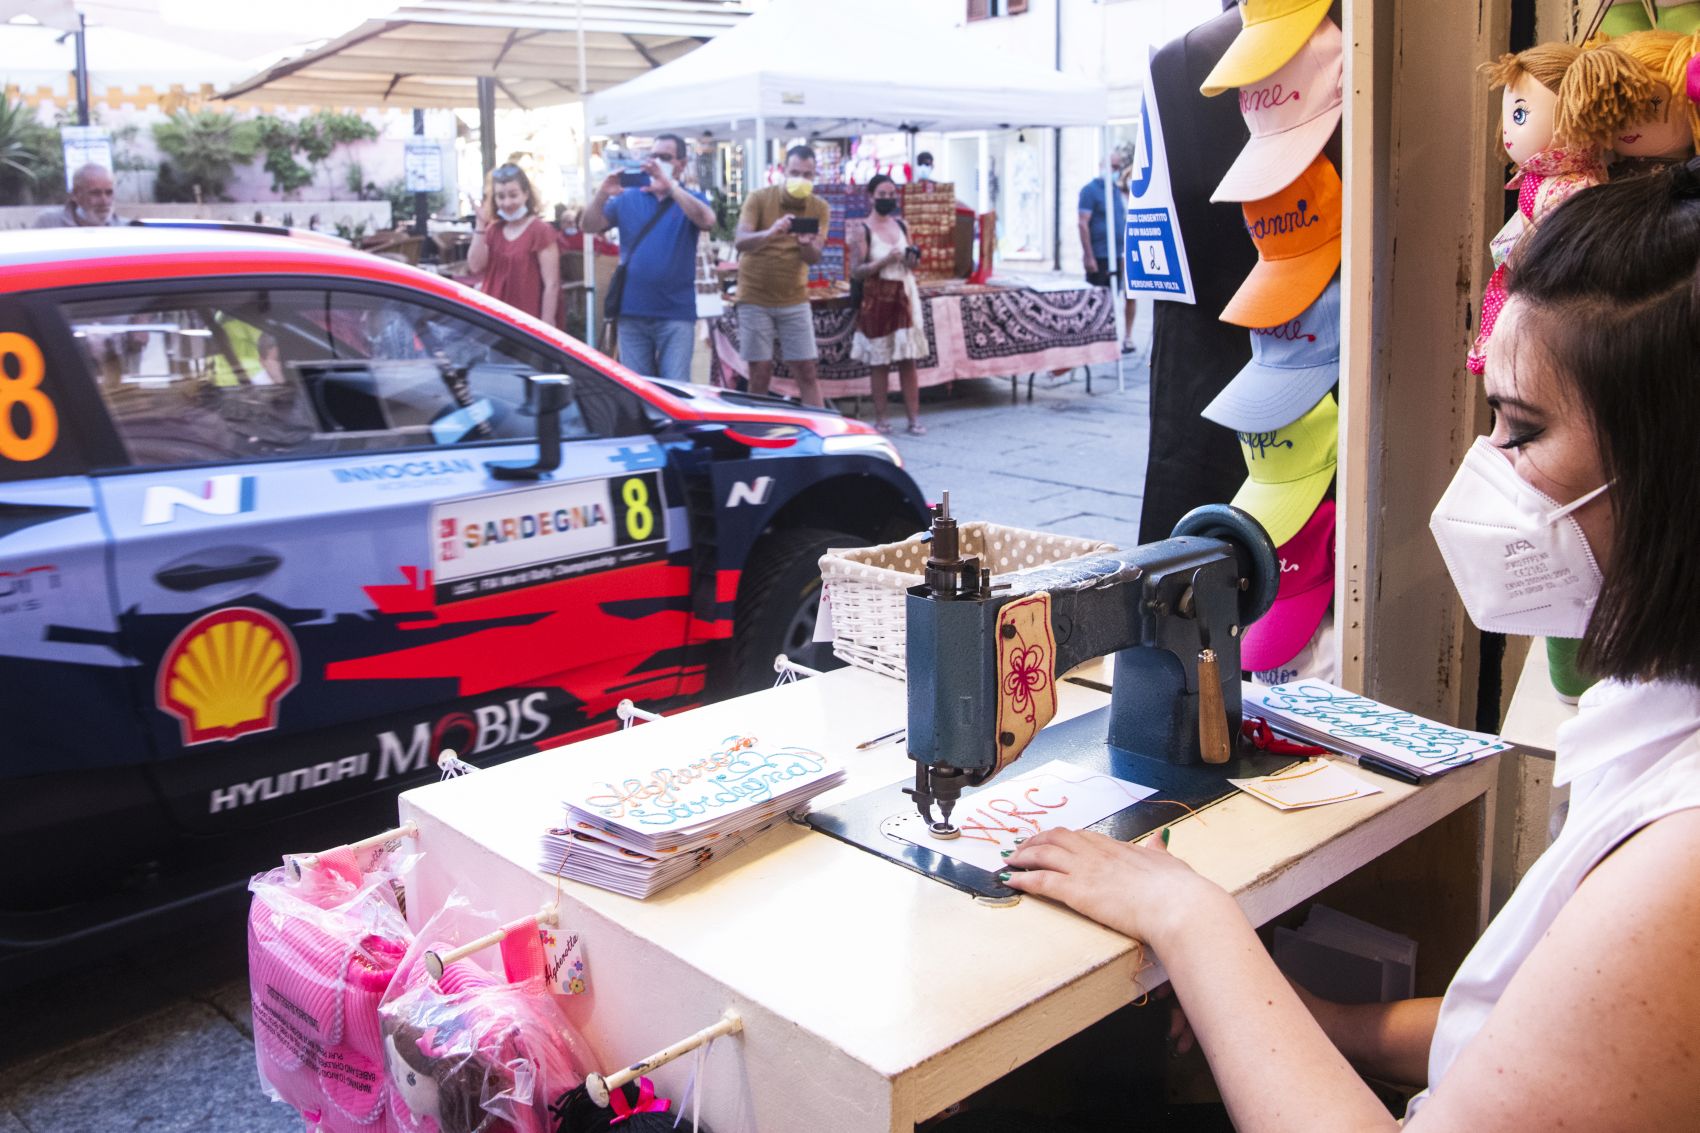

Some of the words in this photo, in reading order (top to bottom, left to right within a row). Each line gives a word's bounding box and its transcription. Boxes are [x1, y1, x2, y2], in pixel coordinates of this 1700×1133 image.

[1131, 250, 1139, 262] DI
[1154, 280, 1165, 289] PER
[1165, 281, 1180, 290] VOLTA
[0, 331, 58, 462] 8
[331, 460, 474, 483] INNOCEAN
[463, 503, 608, 549] SARDEGNA
[621, 478, 655, 541] 8
[210, 753, 370, 814] HYUNDAI
[374, 691, 550, 781] MOBIS
[960, 788, 1069, 844] WRC
